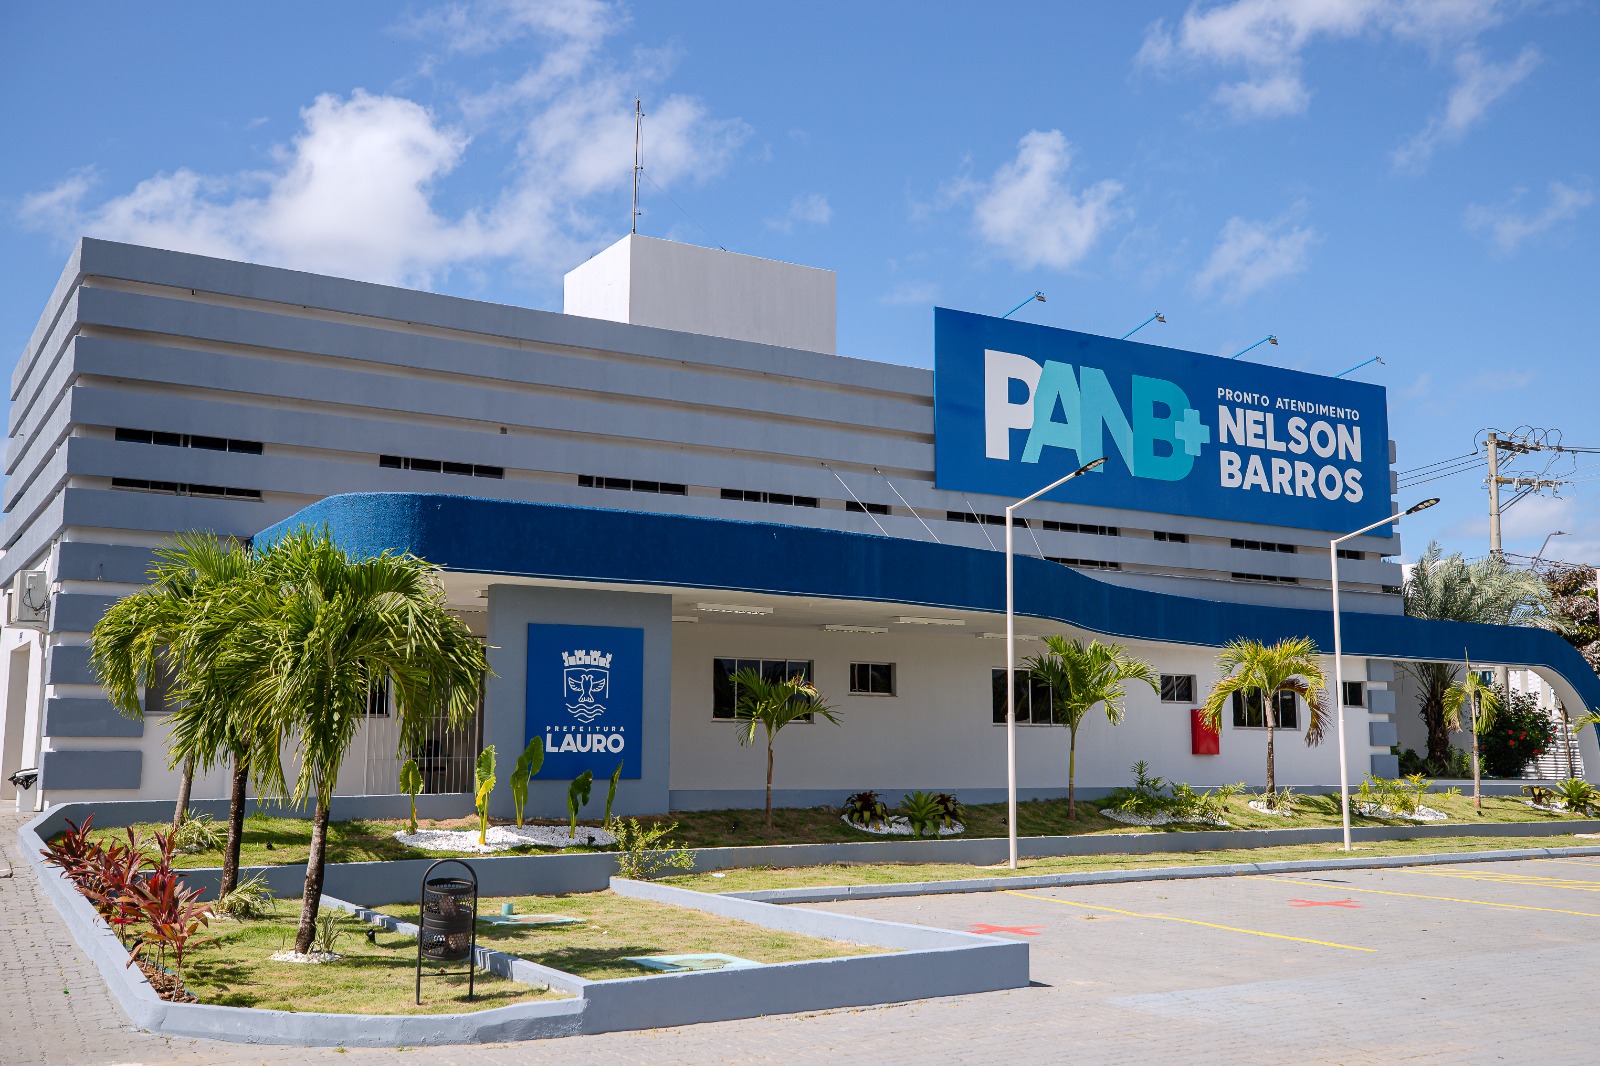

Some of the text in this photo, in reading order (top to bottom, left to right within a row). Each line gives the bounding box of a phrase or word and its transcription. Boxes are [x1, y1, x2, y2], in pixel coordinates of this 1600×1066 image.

[1217, 387, 1360, 421] PRONTO ATENDIMENTO
[1218, 405, 1362, 462] NELSON
[1220, 450, 1364, 503] BARROS
[545, 733, 625, 754] LAURO
